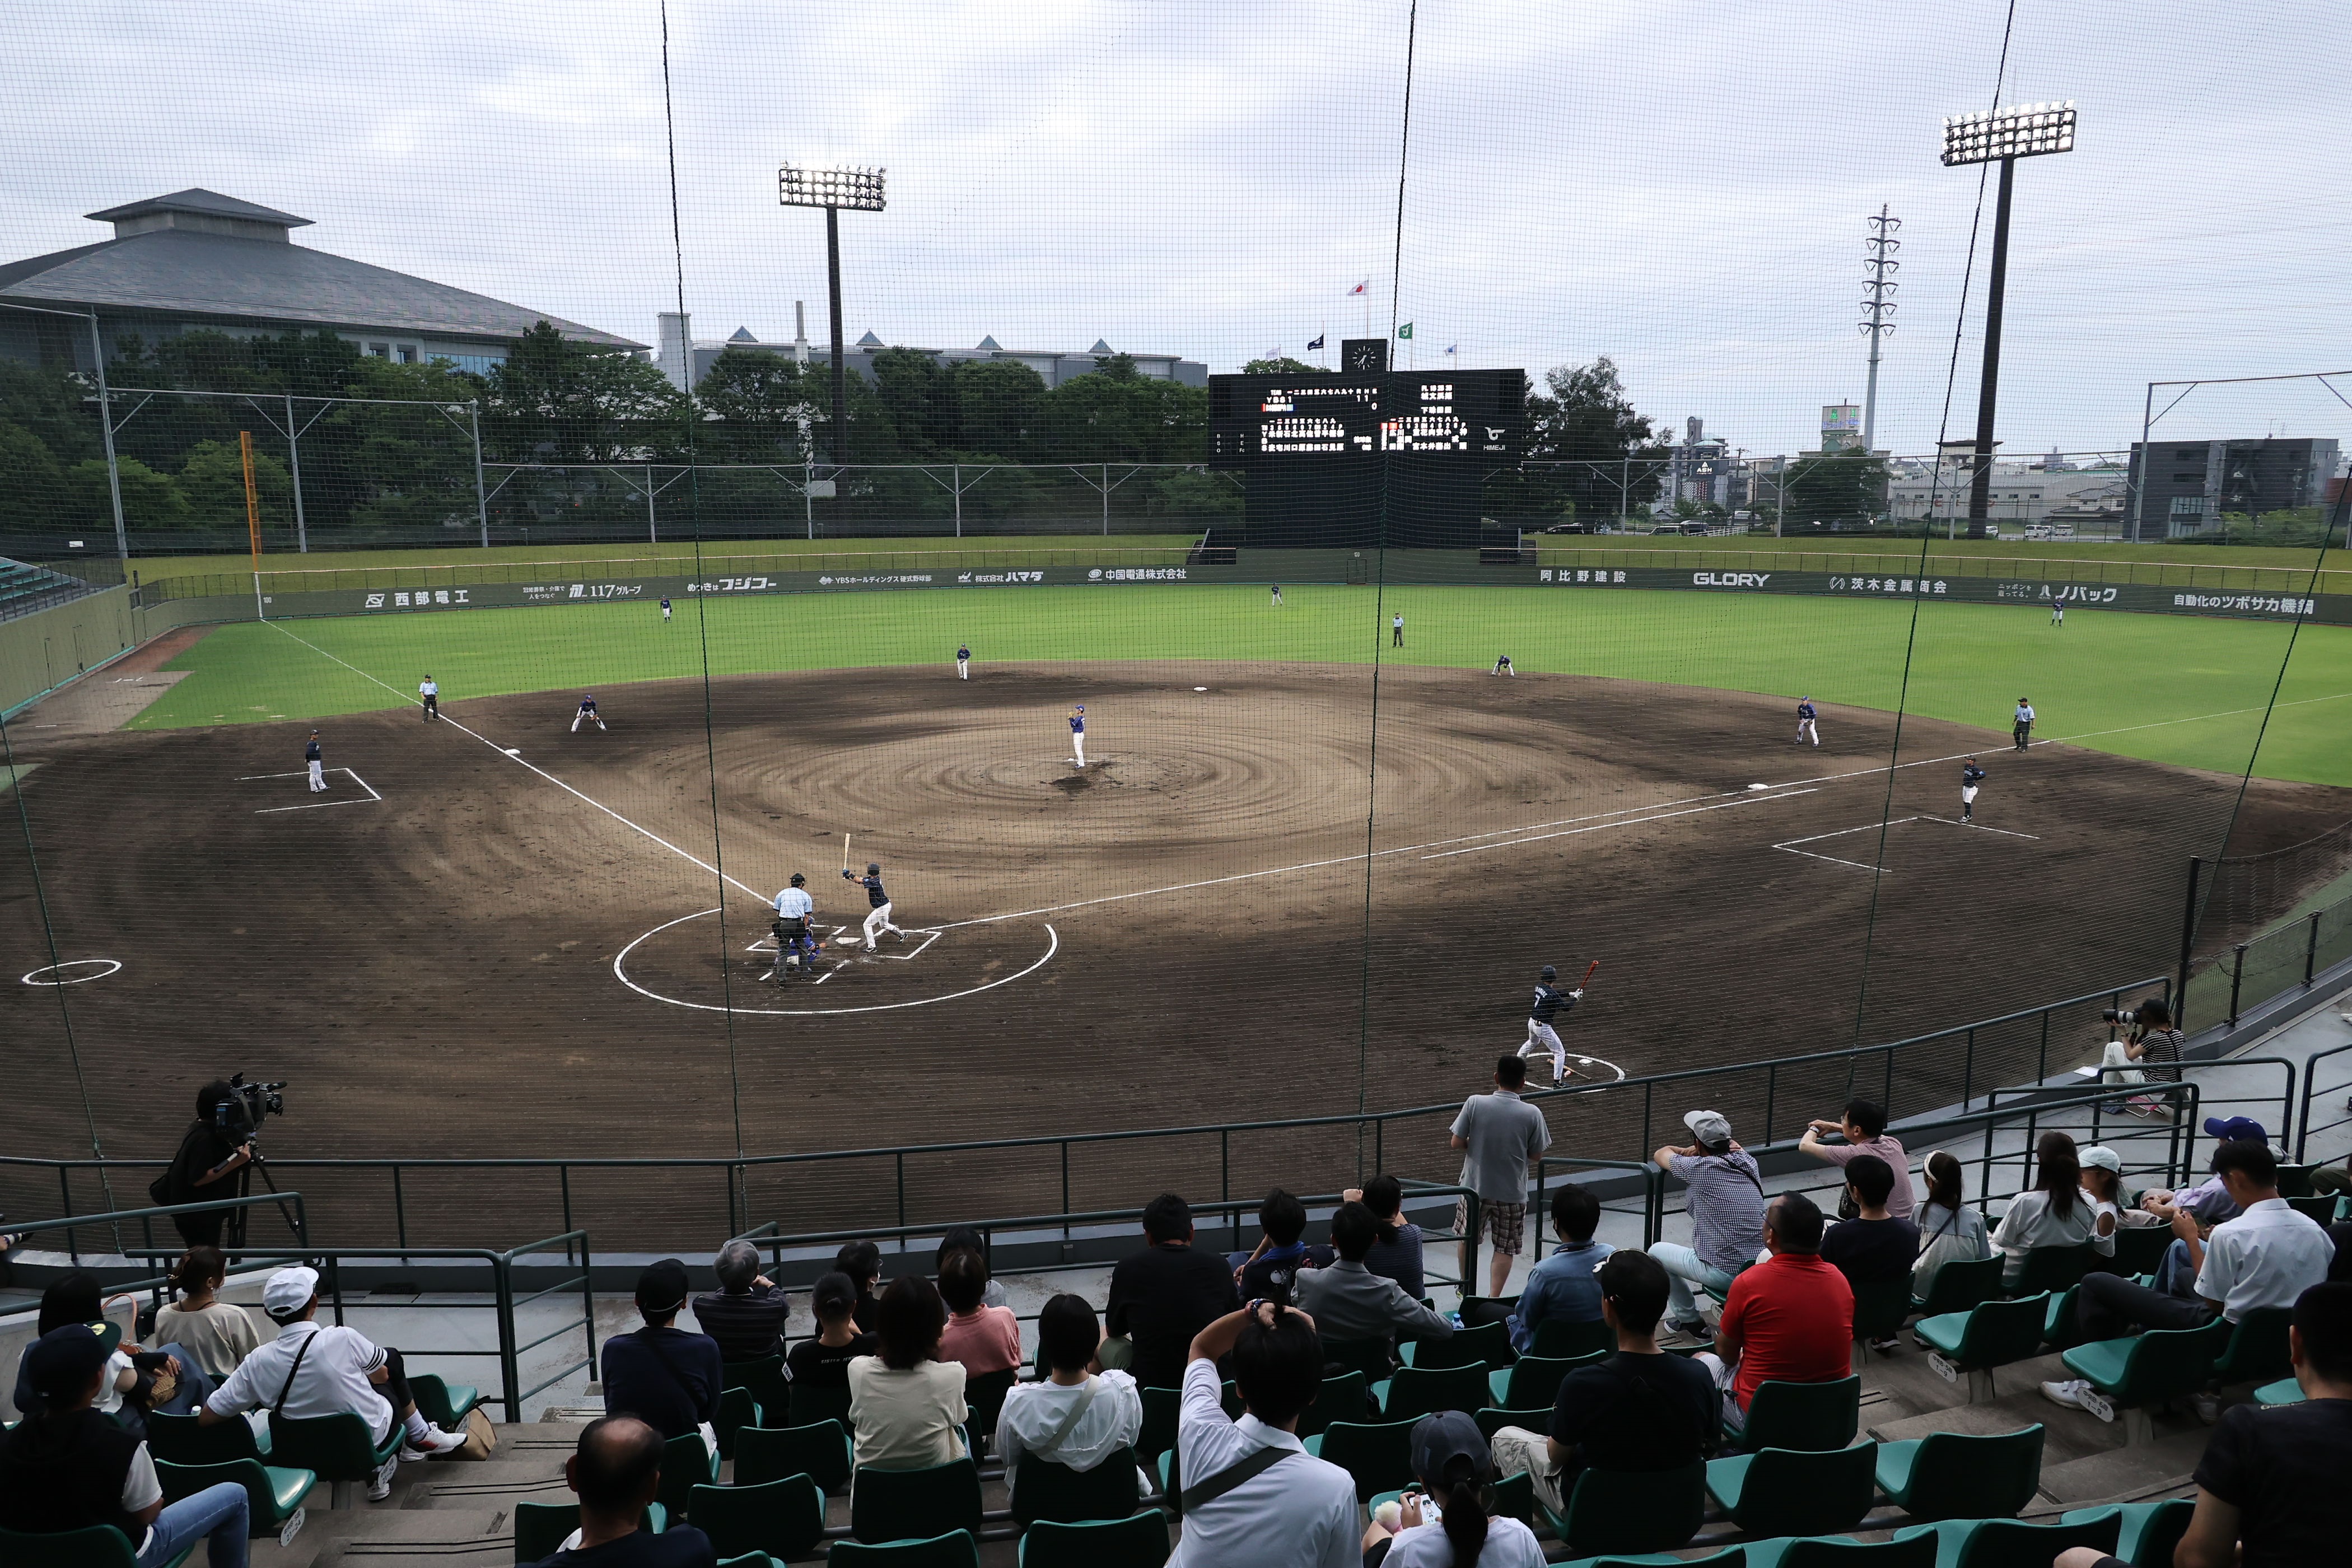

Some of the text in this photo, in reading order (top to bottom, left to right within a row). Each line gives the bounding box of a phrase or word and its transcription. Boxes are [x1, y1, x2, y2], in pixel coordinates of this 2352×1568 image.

[835, 576, 899, 584] YBSホールディングス
[975, 571, 1044, 583] 株式会社 ハマダ
[1105, 568, 1187, 580] 中国電通株式会社
[1540, 570, 1626, 583] 阿比野建設
[1693, 572, 1771, 587] GLORY
[718, 577, 777, 590] フジコー
[1851, 577, 1947, 594] 茨木金属商会
[394, 590, 469, 606] 西部電工
[2055, 586, 2117, 602] ノバック
[2174, 594, 2314, 614] 自動化のツボサカ機鋼
